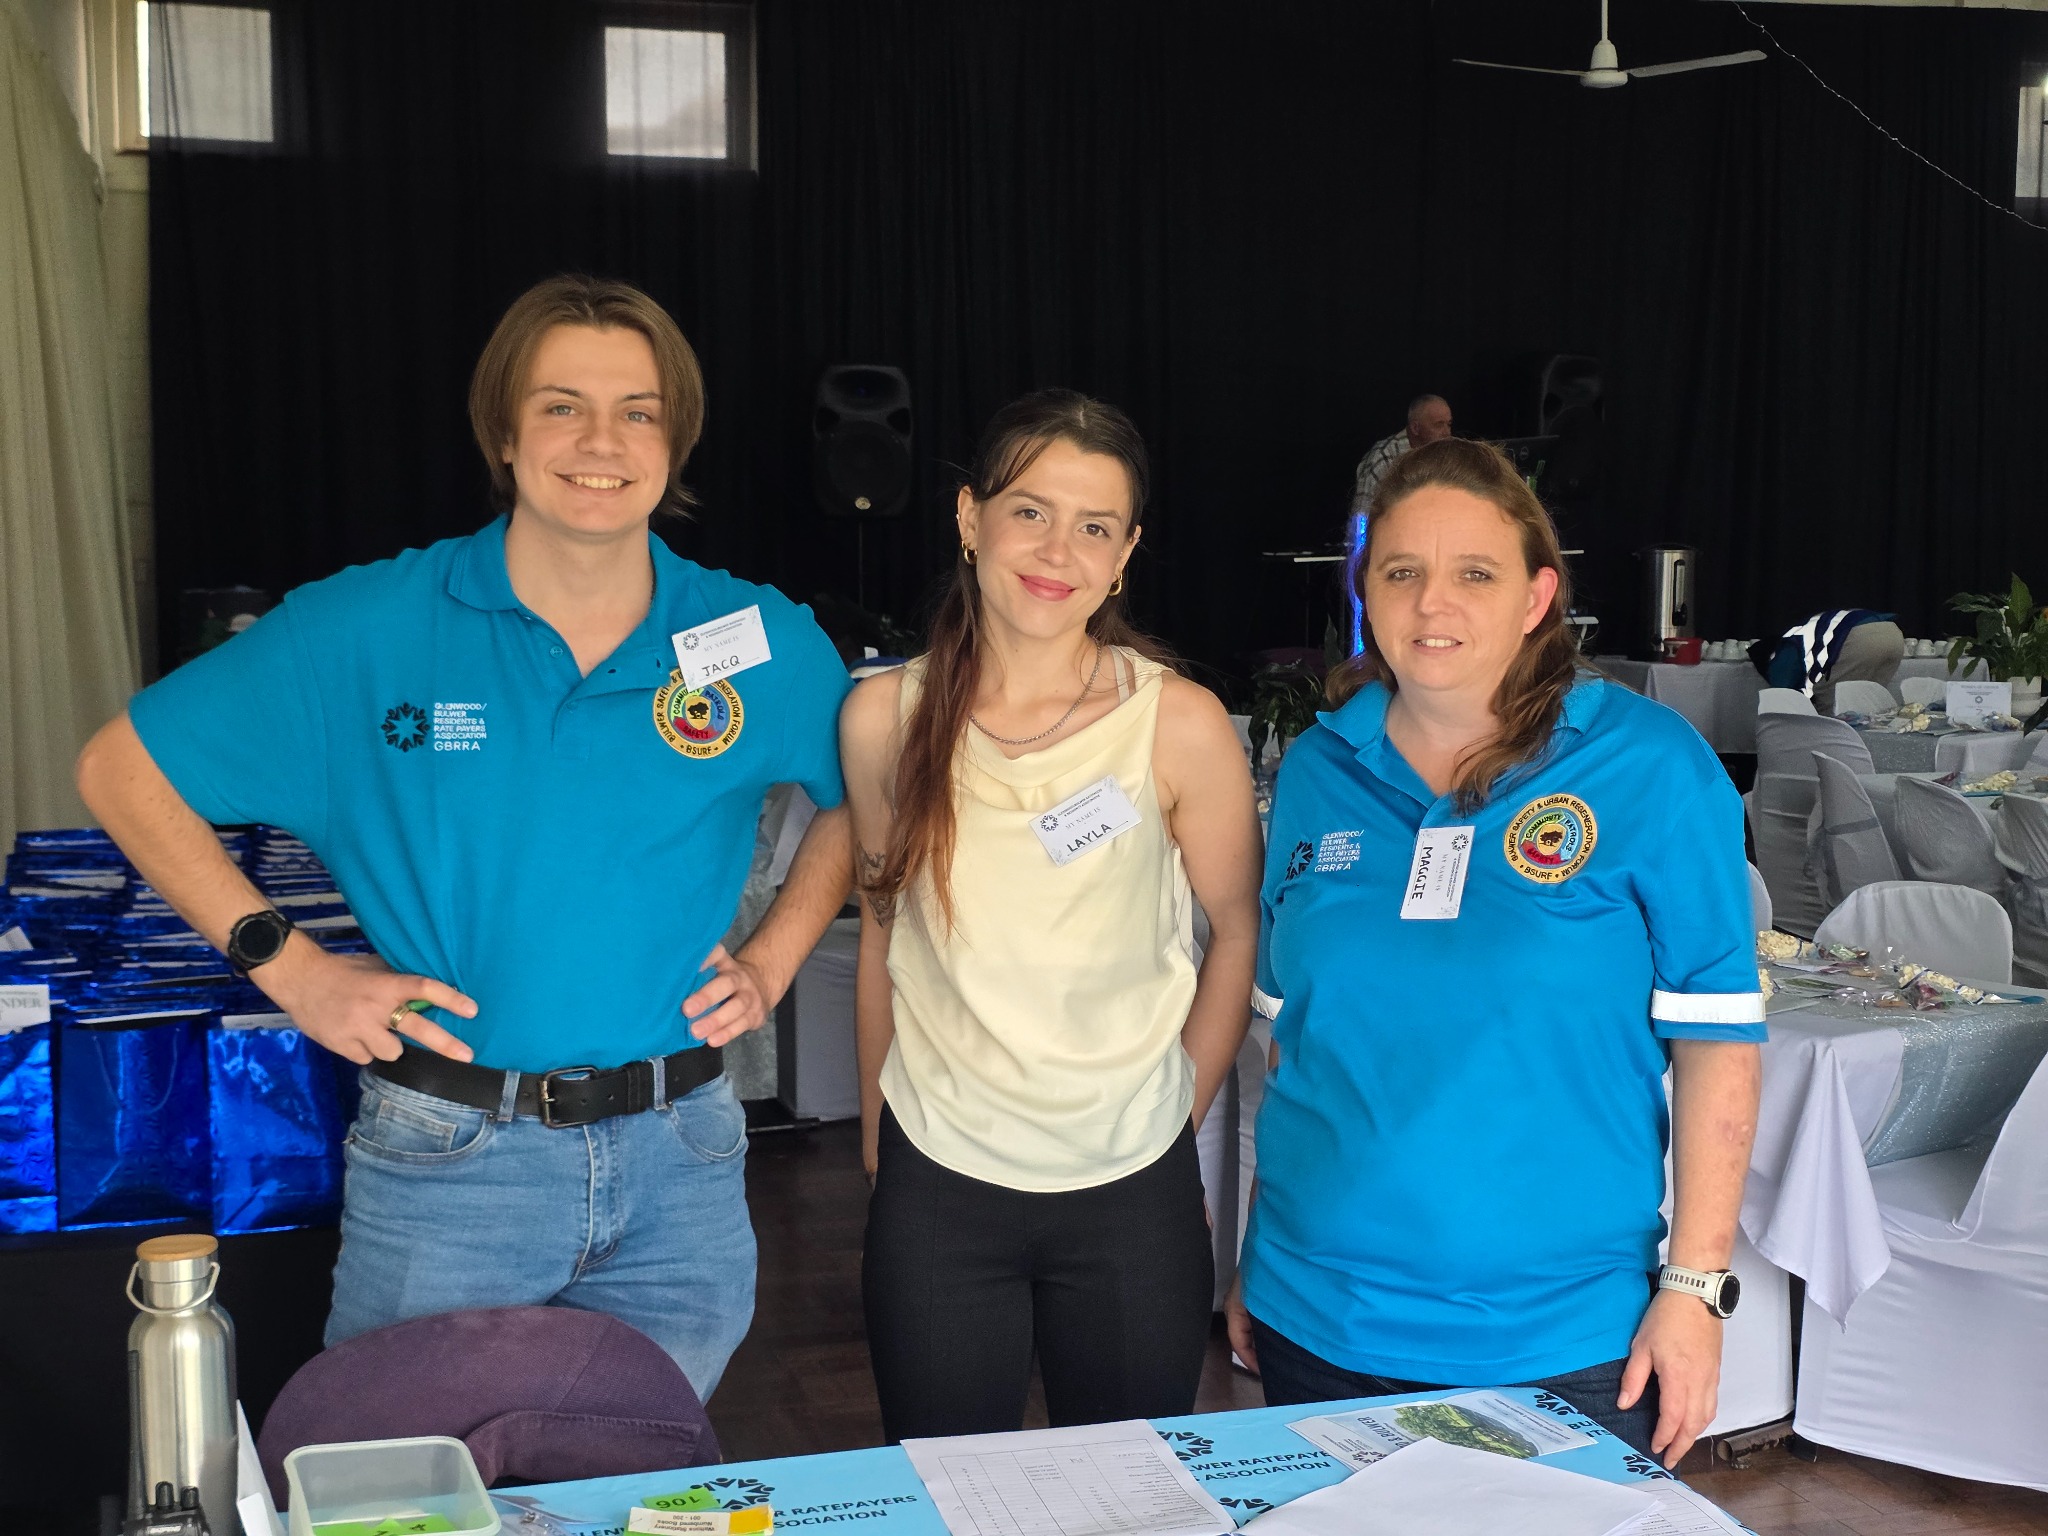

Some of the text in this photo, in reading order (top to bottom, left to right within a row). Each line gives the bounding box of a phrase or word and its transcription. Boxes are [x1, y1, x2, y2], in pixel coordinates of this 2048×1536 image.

[702, 655, 740, 677] JACQ
[656, 686, 670, 710] SAFET
[434, 710, 467, 718] BULWER
[434, 717, 478, 725] RESIDENTS
[434, 732, 487, 740] ASSOCIATION
[434, 740, 481, 751] GBRRA
[1066, 823, 1112, 852] LAYLA
[1512, 807, 1536, 832] SAFETY
[1543, 796, 1570, 806] URBAN
[1560, 854, 1585, 877] FORUM
[1411, 846, 1433, 899] MAGGIE
[1524, 866, 1553, 880] BSURF
[1238, 1449, 1332, 1466] RATEPAYE
[1205, 1461, 1332, 1481] ASSOCIATION
[656, 1495, 701, 1509] 106
[791, 1495, 918, 1516] RATEPAYERS
[774, 1509, 888, 1529] SOCIATION
